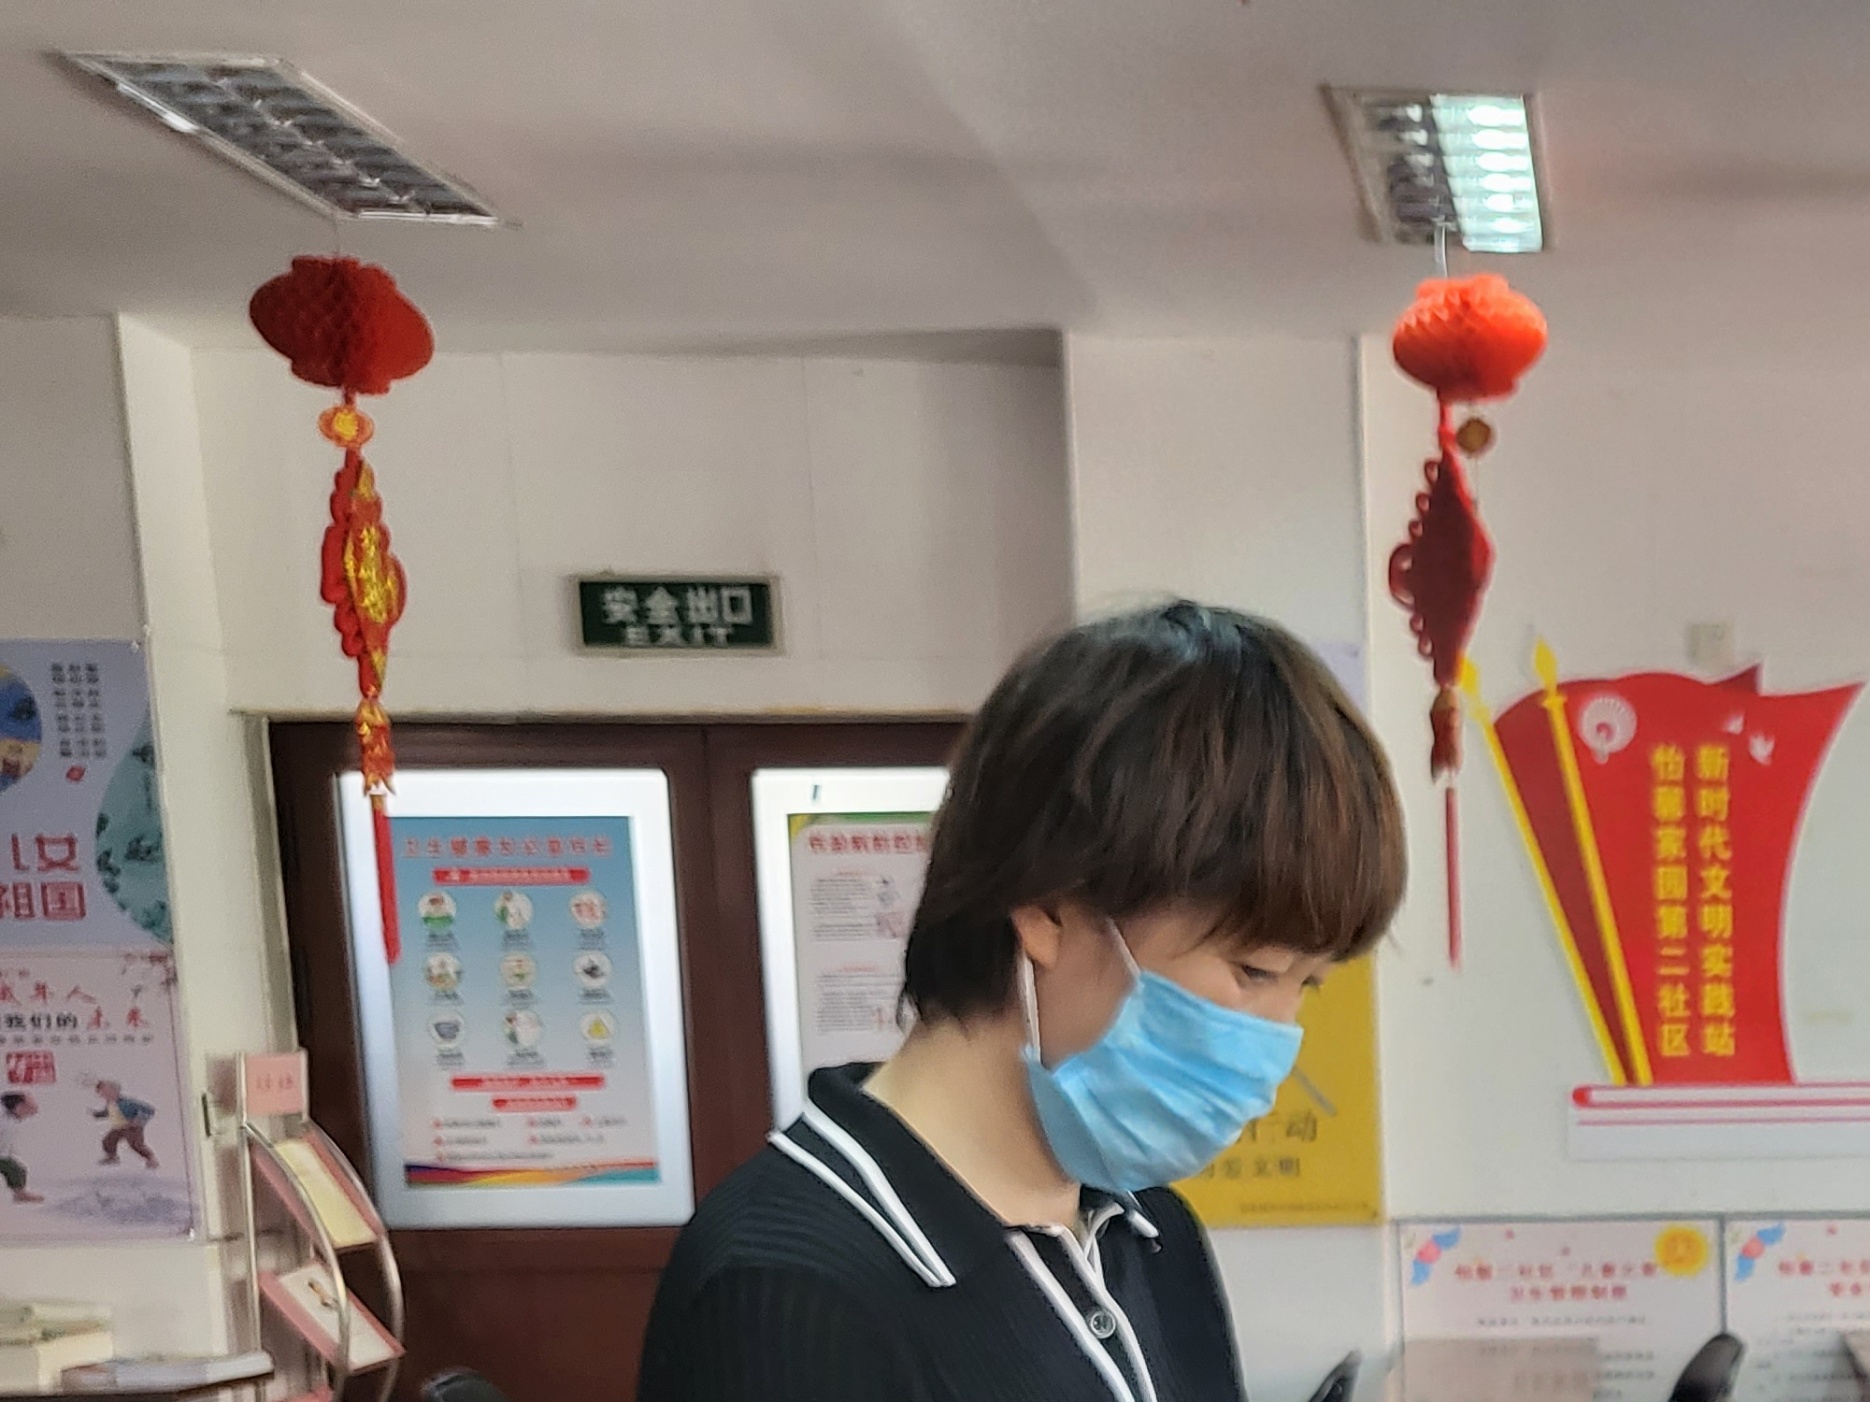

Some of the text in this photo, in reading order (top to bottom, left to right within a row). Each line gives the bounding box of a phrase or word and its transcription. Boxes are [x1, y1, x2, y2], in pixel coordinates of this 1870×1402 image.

[602, 585, 753, 625] 安全出口
[622, 626, 735, 648] EXIT
[1696, 744, 1736, 1057] 新时代文明实践站
